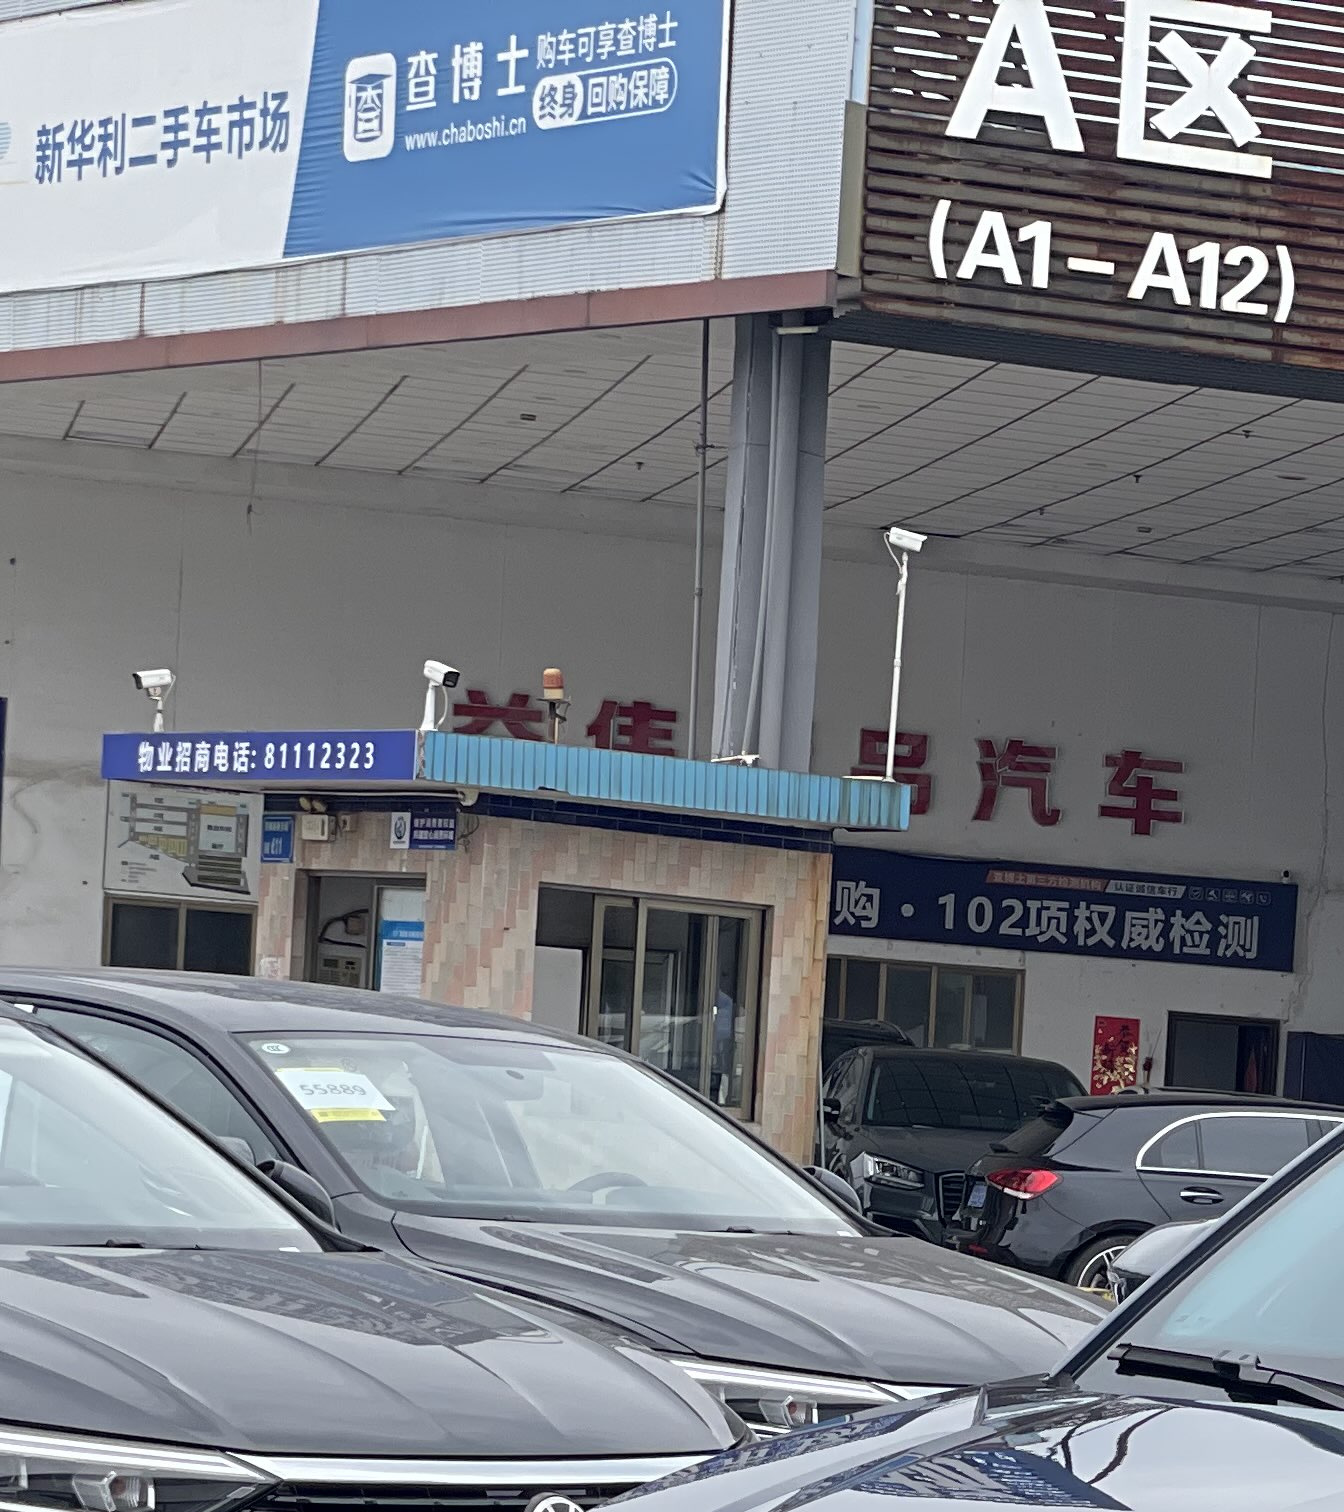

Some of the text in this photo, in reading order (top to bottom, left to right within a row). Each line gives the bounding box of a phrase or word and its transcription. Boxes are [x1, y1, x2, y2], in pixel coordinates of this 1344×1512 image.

[536, 11, 679, 70] 购车可享查博士
[405, 34, 529, 111] 查博士
[538, 65, 671, 120] 终身 回购保障
[944, 0, 1273, 180] A区
[35, 91, 290, 184] 新华利二手车市场
[404, 115, 527, 151] www.chaboshi.cn
[299, 1083, 367, 1097] 55889
